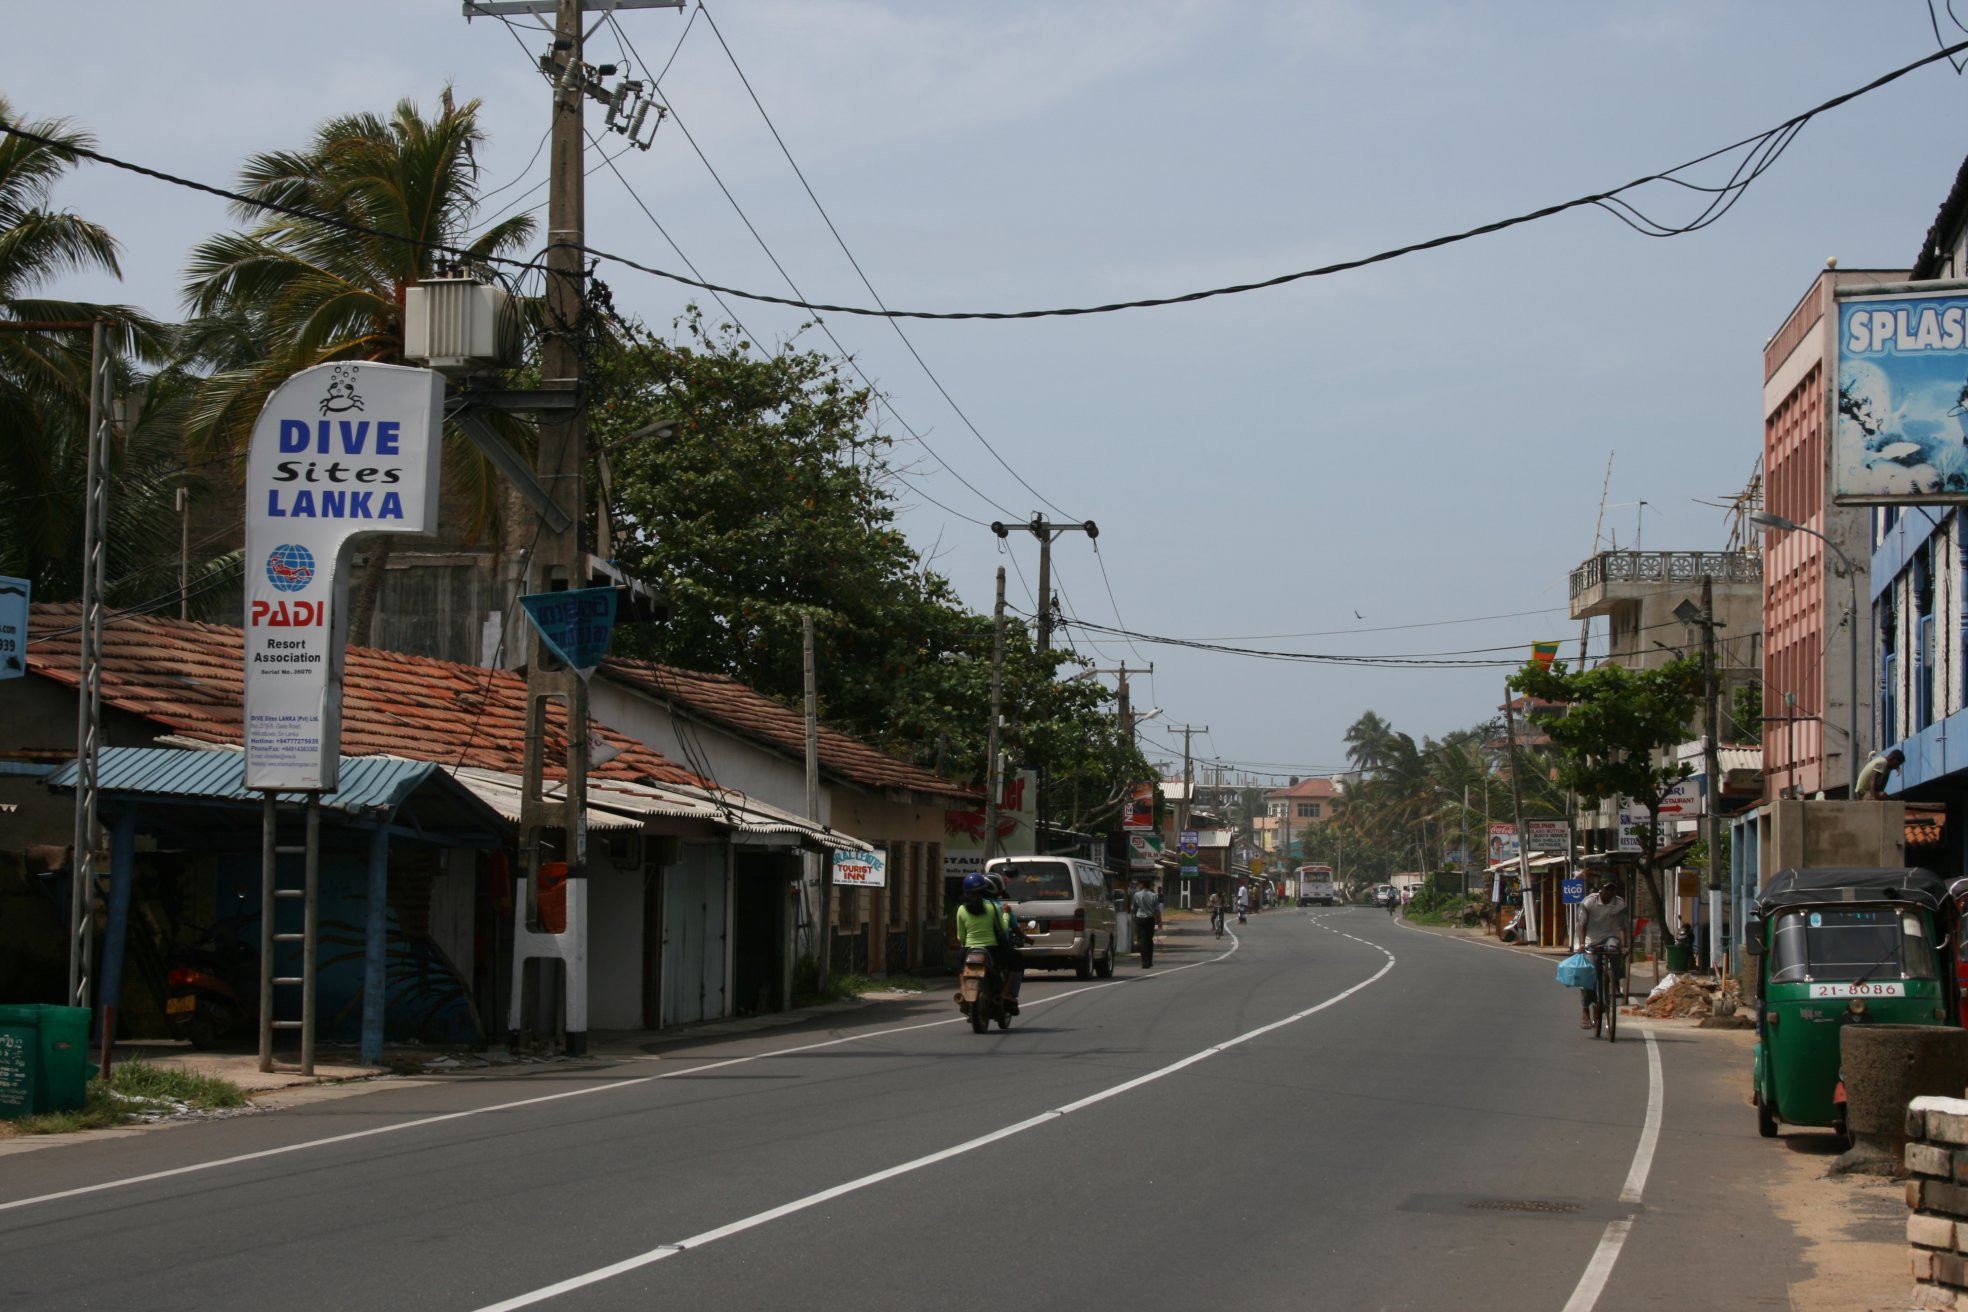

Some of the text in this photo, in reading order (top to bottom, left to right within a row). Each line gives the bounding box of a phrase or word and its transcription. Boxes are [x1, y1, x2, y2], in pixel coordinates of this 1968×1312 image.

[1848, 306, 1968, 353] SPLAS
[279, 419, 401, 455] DIVE
[271, 461, 403, 484] Sites
[268, 489, 404, 519] LANKA
[252, 600, 324, 627] PADI
[267, 639, 306, 649] Resort
[254, 652, 321, 663] Association
[838, 864, 873, 874] TOURIST
[844, 872, 866, 880] INN
